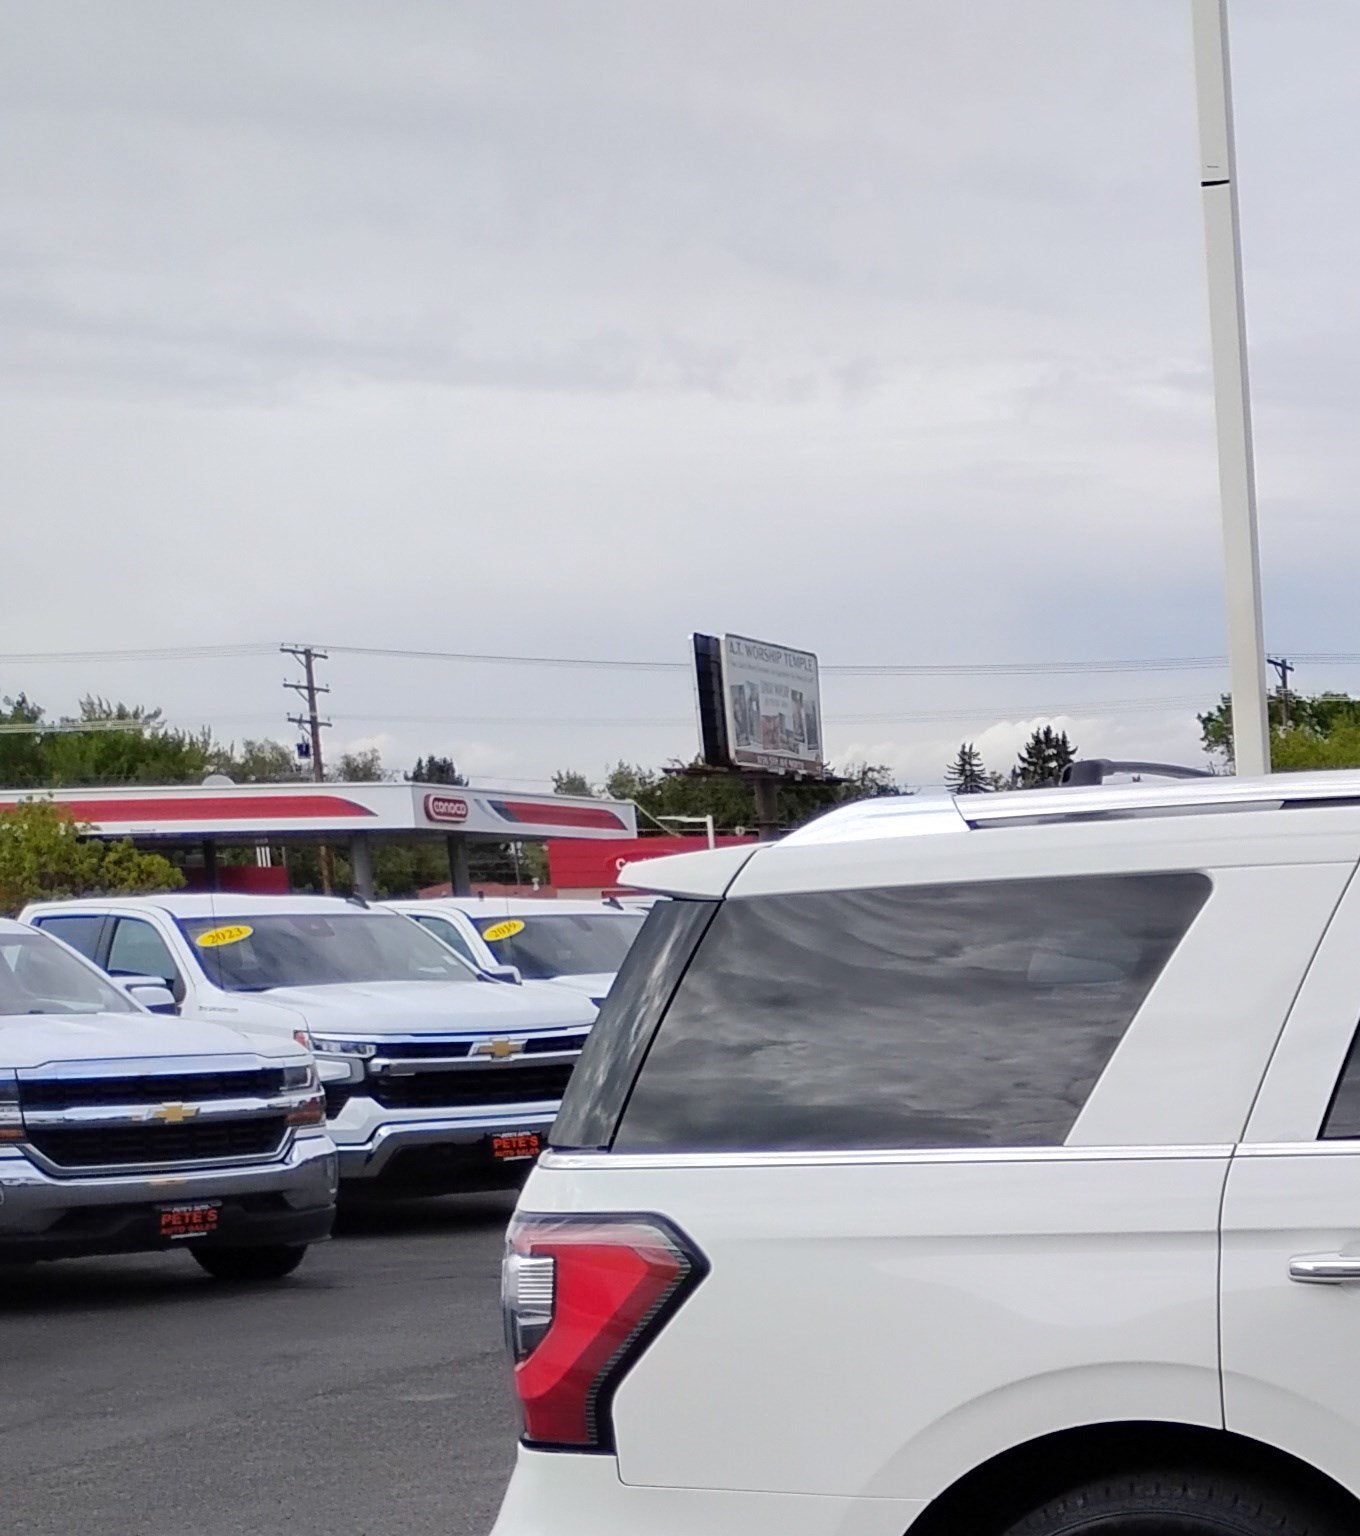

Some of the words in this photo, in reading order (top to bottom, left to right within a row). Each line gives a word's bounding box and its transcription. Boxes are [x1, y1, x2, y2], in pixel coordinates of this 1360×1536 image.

[745, 645, 782, 664] WORSHIP
[784, 653, 814, 673] TEMPLE
[206, 927, 244, 944] 2023
[160, 1208, 218, 1226] PETE'S
